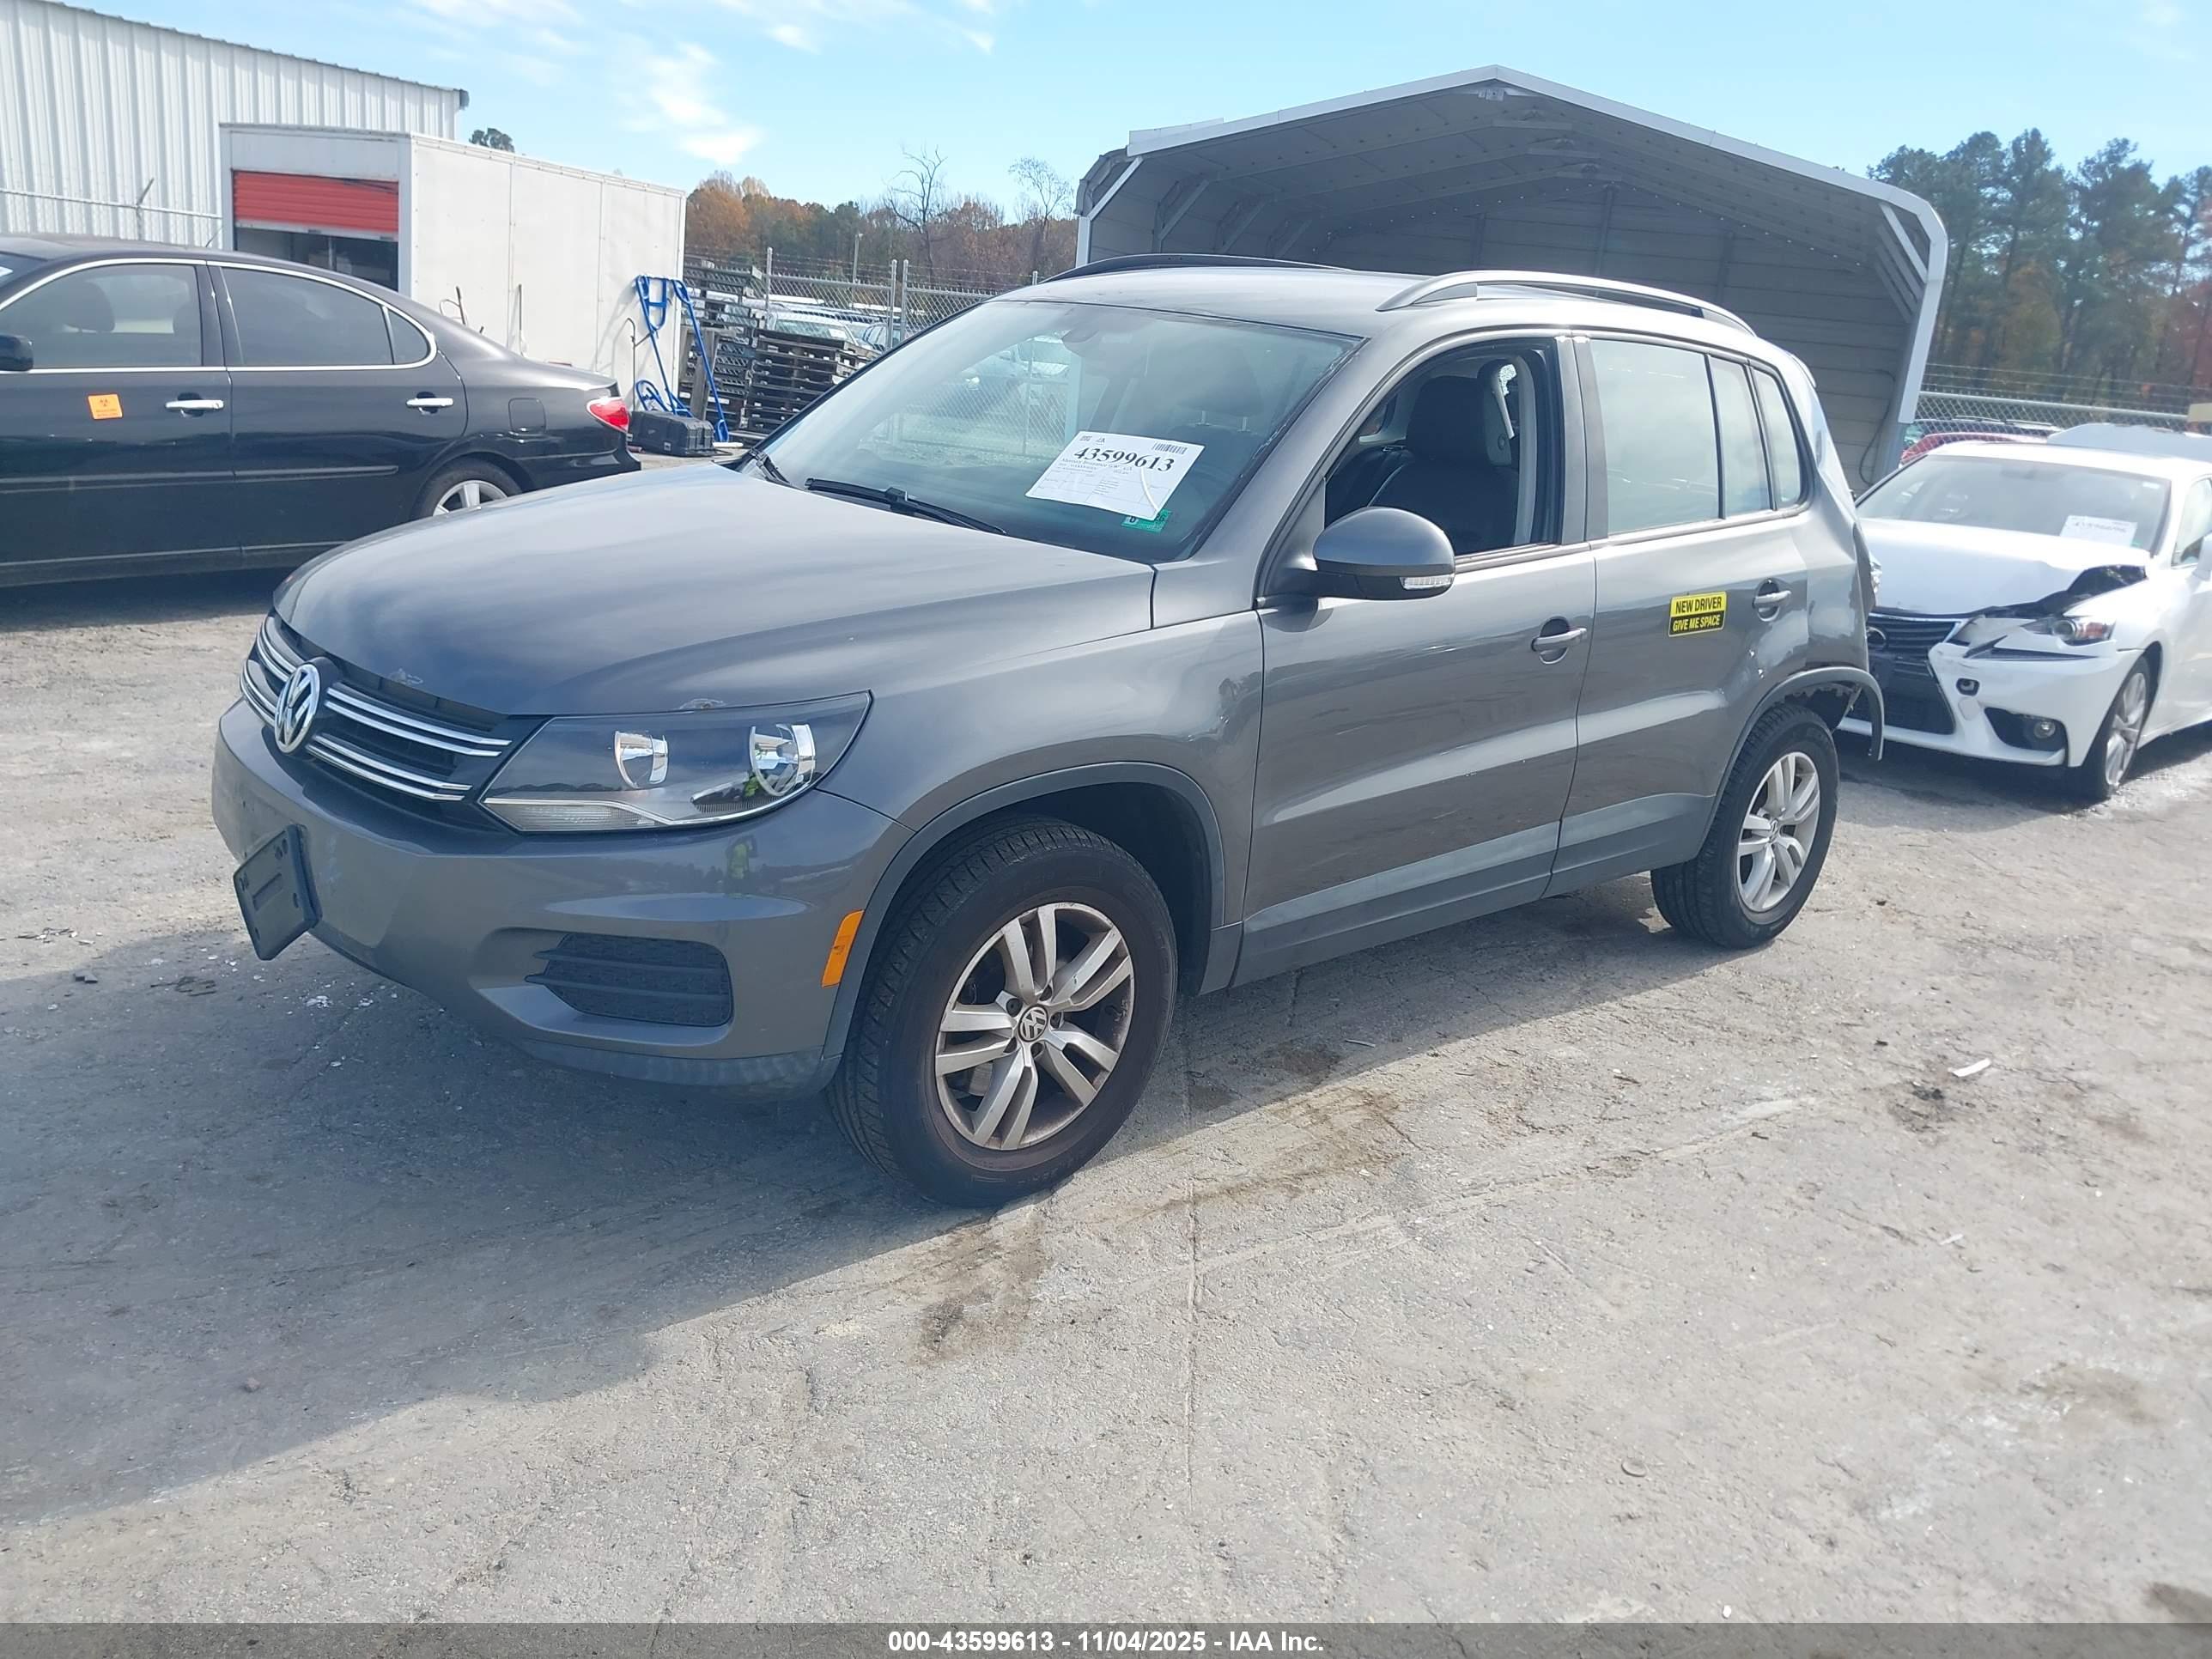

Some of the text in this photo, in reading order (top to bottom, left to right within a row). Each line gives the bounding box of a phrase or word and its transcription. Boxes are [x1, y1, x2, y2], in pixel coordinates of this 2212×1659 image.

[1074, 447, 1175, 472] 43599613
[1675, 596, 1722, 614] NEW DRIVER
[1673, 614, 1721, 632] GIVE ME SPACE
